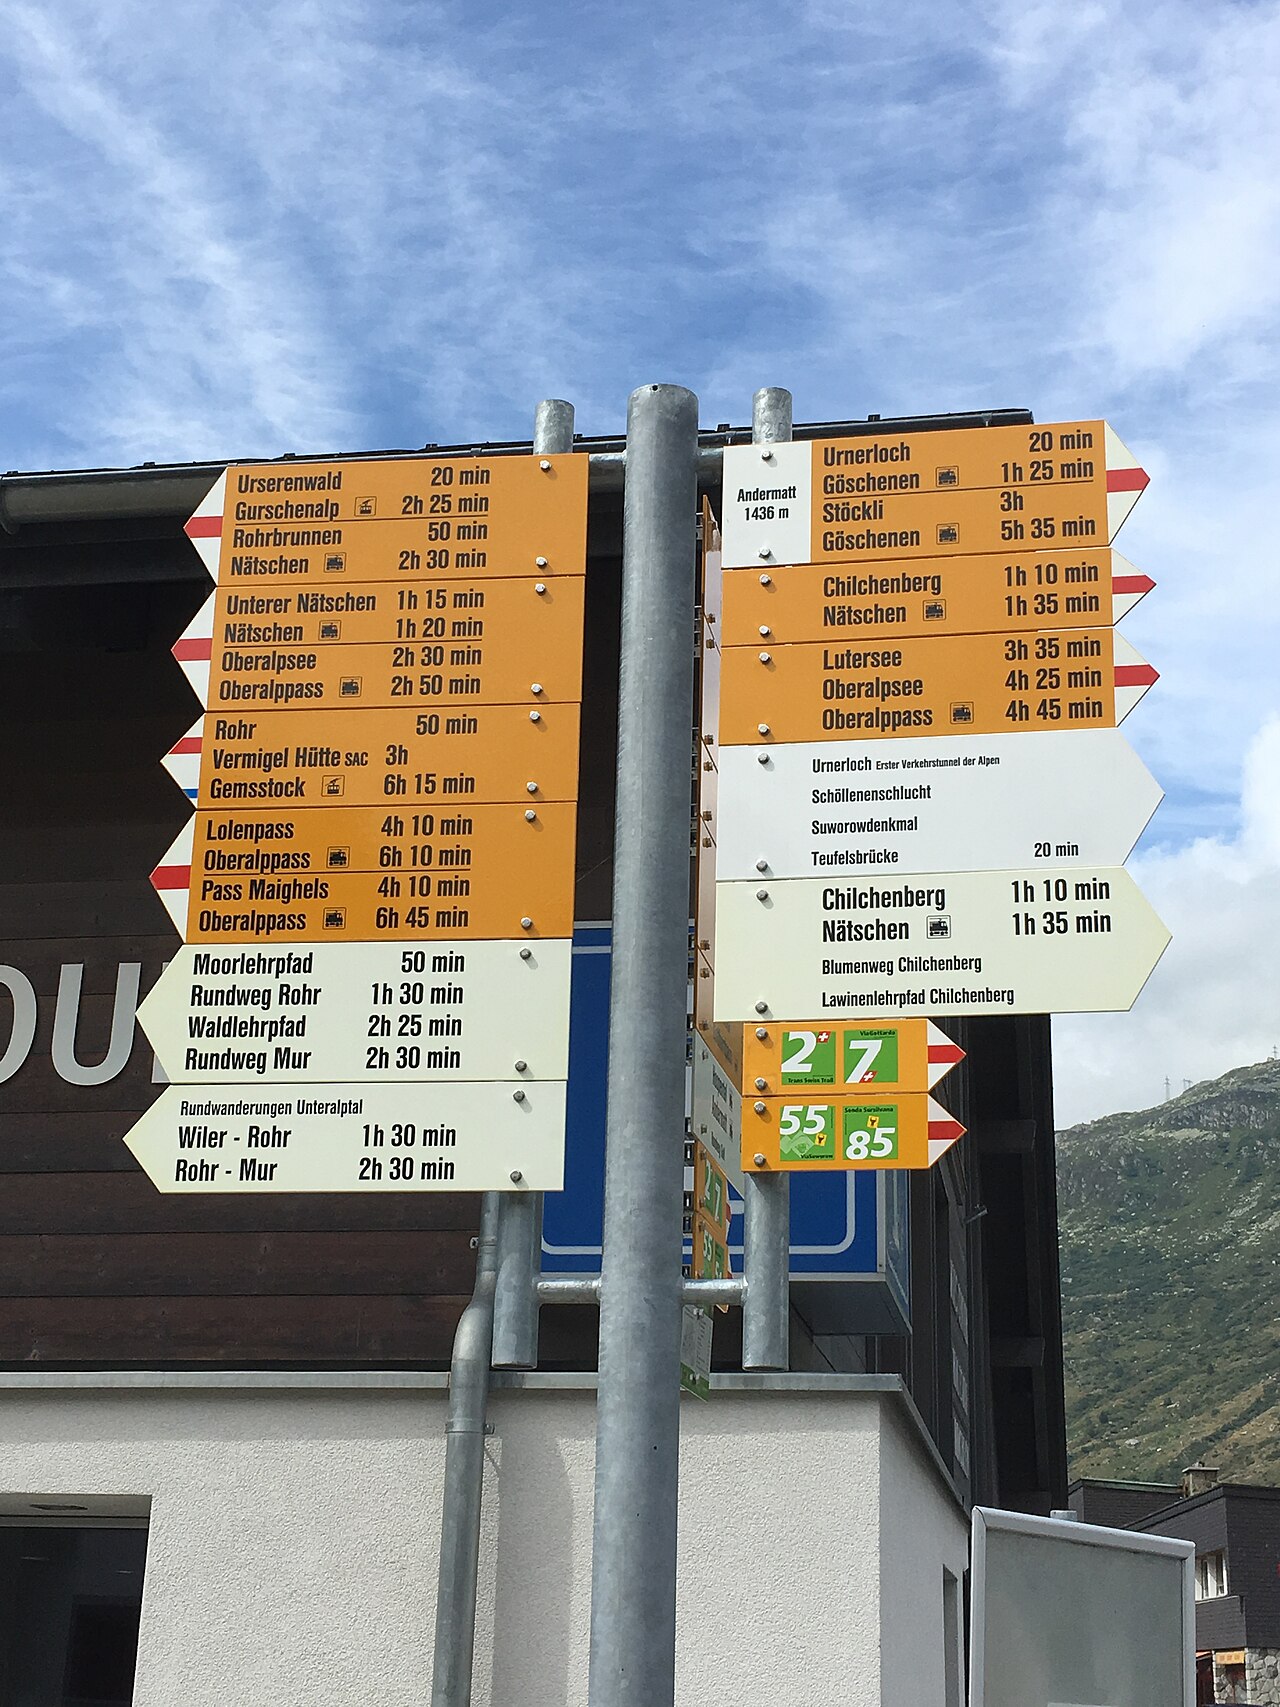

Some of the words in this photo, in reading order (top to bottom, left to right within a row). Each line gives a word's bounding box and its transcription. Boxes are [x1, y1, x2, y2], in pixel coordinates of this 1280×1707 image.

[824, 442, 910, 466] Urnerloch
[1029, 432, 1052, 452] 20
[1060, 433, 1092, 450] min
[238, 471, 342, 493] Urserenwald
[431, 467, 453, 486] 20
[460, 466, 490, 485] min
[823, 471, 919, 495] Göschenen
[1002, 462, 1023, 482] 1h
[1030, 460, 1053, 481] 25
[1060, 459, 1093, 479] min
[235, 499, 339, 521] Gurschenalp
[402, 495, 423, 514] 2h
[430, 494, 451, 513] 25
[458, 493, 488, 512] min
[738, 486, 796, 502] Andermatt
[823, 500, 883, 523] Stöckli
[1001, 491, 1023, 511] 3h
[745, 506, 774, 520] 1436
[779, 508, 788, 518] m
[233, 528, 341, 548] Rohrbrunnen
[428, 521, 450, 541] 50
[457, 521, 487, 540] min
[823, 529, 919, 551] Göschenen
[1002, 520, 1024, 540] 5h
[1031, 517, 1055, 538] 35
[1062, 516, 1095, 536] min
[231, 555, 308, 575] Nätschen
[399, 551, 420, 570] 2h
[427, 549, 449, 569] 30
[456, 549, 486, 568] min
[824, 573, 941, 597] Chilchenberg
[1005, 566, 1026, 586] 1h
[1035, 564, 1057, 585] 10
[1065, 562, 1098, 583] min
[227, 595, 291, 615] Unterer
[297, 592, 376, 613] Nätschen
[398, 590, 417, 610] 1h
[426, 589, 446, 609] 15
[453, 588, 484, 608] min
[824, 604, 906, 626] Nätschen
[1005, 596, 1027, 616] 1h
[1034, 593, 1058, 614] 35
[1066, 592, 1099, 613] min
[225, 622, 303, 643] Nätschen
[397, 619, 416, 638] 1h
[422, 617, 445, 637] 20
[452, 617, 483, 636] min
[222, 651, 316, 674] Oberalpsee
[393, 647, 414, 667] 2h
[421, 646, 444, 666] 30
[451, 645, 481, 665] min
[824, 650, 901, 670] Lutersee
[1005, 640, 1028, 661] 3h
[1035, 638, 1059, 659] 35
[1067, 637, 1100, 657] min
[220, 679, 323, 703] Oberalppass
[391, 676, 413, 696] 2h
[420, 675, 442, 695] 50
[449, 674, 480, 694] min
[823, 677, 923, 702] Oberalpsee
[1005, 670, 1028, 691] 4h
[1036, 668, 1060, 689] 25
[1068, 666, 1101, 688] min
[823, 707, 932, 732] Oberalppass
[1006, 700, 1029, 721] 4h
[1037, 698, 1061, 720] 45
[1069, 697, 1102, 718] min
[213, 748, 288, 772] Vermigel
[295, 747, 340, 767] Hütte
[345, 752, 368, 766] SAC
[386, 745, 408, 765] 3h
[813, 757, 871, 773] Urnerloch
[876, 761, 899, 770] Erster
[902, 757, 960, 768] Verkehrstunnel
[963, 757, 976, 765] der
[978, 756, 999, 766] Alpen
[211, 777, 305, 799] Gemsstock
[384, 774, 406, 795] 6h
[415, 774, 436, 794] 15
[443, 773, 474, 793] min
[812, 785, 931, 803] Schöllenenschlucht
[207, 820, 294, 844] Lolenpass
[381, 816, 403, 836] 4h
[412, 815, 433, 836] 10
[440, 814, 472, 835] min
[812, 816, 917, 834] Suworowdenkmal
[204, 849, 310, 874] Oberalppass
[380, 846, 402, 867] 6h
[411, 845, 432, 866] 10
[439, 845, 471, 865] min
[811, 849, 898, 865] Teufelsbrücke
[1035, 843, 1050, 857] 20
[1056, 842, 1078, 856] min
[202, 880, 242, 901] Pass
[249, 878, 329, 901] Maighels
[378, 877, 400, 897] 4h
[409, 876, 430, 897] 10
[437, 875, 469, 896] min
[823, 886, 945, 911] Chilchenberg
[1012, 881, 1034, 902] 1h
[1043, 879, 1067, 901] 10
[1075, 878, 1109, 900] min
[199, 910, 306, 935] Oberalppass
[376, 907, 398, 928] 6h
[405, 907, 429, 928] 45
[436, 906, 468, 927] min
[823, 919, 909, 942] Nätschen
[1013, 913, 1035, 935] 1h
[1043, 911, 1068, 934] 35
[1076, 910, 1111, 933] min
[194, 952, 313, 978] Moorlehrpfad
[402, 951, 425, 973] 50
[432, 951, 464, 972] min
[823, 960, 893, 976] Blumenweg
[899, 955, 981, 973] Chilchenberg
[191, 985, 271, 1010] Rundweg
[279, 984, 321, 1005] Rohr
[372, 983, 392, 1004] 1h
[400, 983, 423, 1004] 30
[431, 982, 463, 1004] min
[823, 989, 925, 1008] Lawinenlehrpfad
[930, 987, 1014, 1005] Chilchenberg
[189, 1015, 306, 1042] Waldlehrpfad
[368, 1015, 391, 1036] 2h
[398, 1015, 422, 1036] 25
[429, 1014, 461, 1036] min
[185, 1048, 267, 1074] Rundweg
[274, 1047, 311, 1069] Mur
[366, 1047, 389, 1069] 2h
[396, 1046, 420, 1068] 30
[427, 1046, 460, 1068] min
[781, 1030, 817, 1073] 2
[845, 1039, 883, 1084] 7
[181, 1100, 292, 1118] Rundwanderungen
[297, 1099, 362, 1117] Unteralptal
[779, 1105, 828, 1135] 55
[179, 1126, 227, 1148] Wiler
[248, 1126, 291, 1147] Rohr
[363, 1125, 384, 1146] 1h
[391, 1124, 415, 1146] 30
[423, 1124, 456, 1146] min
[846, 1127, 896, 1160] 85
